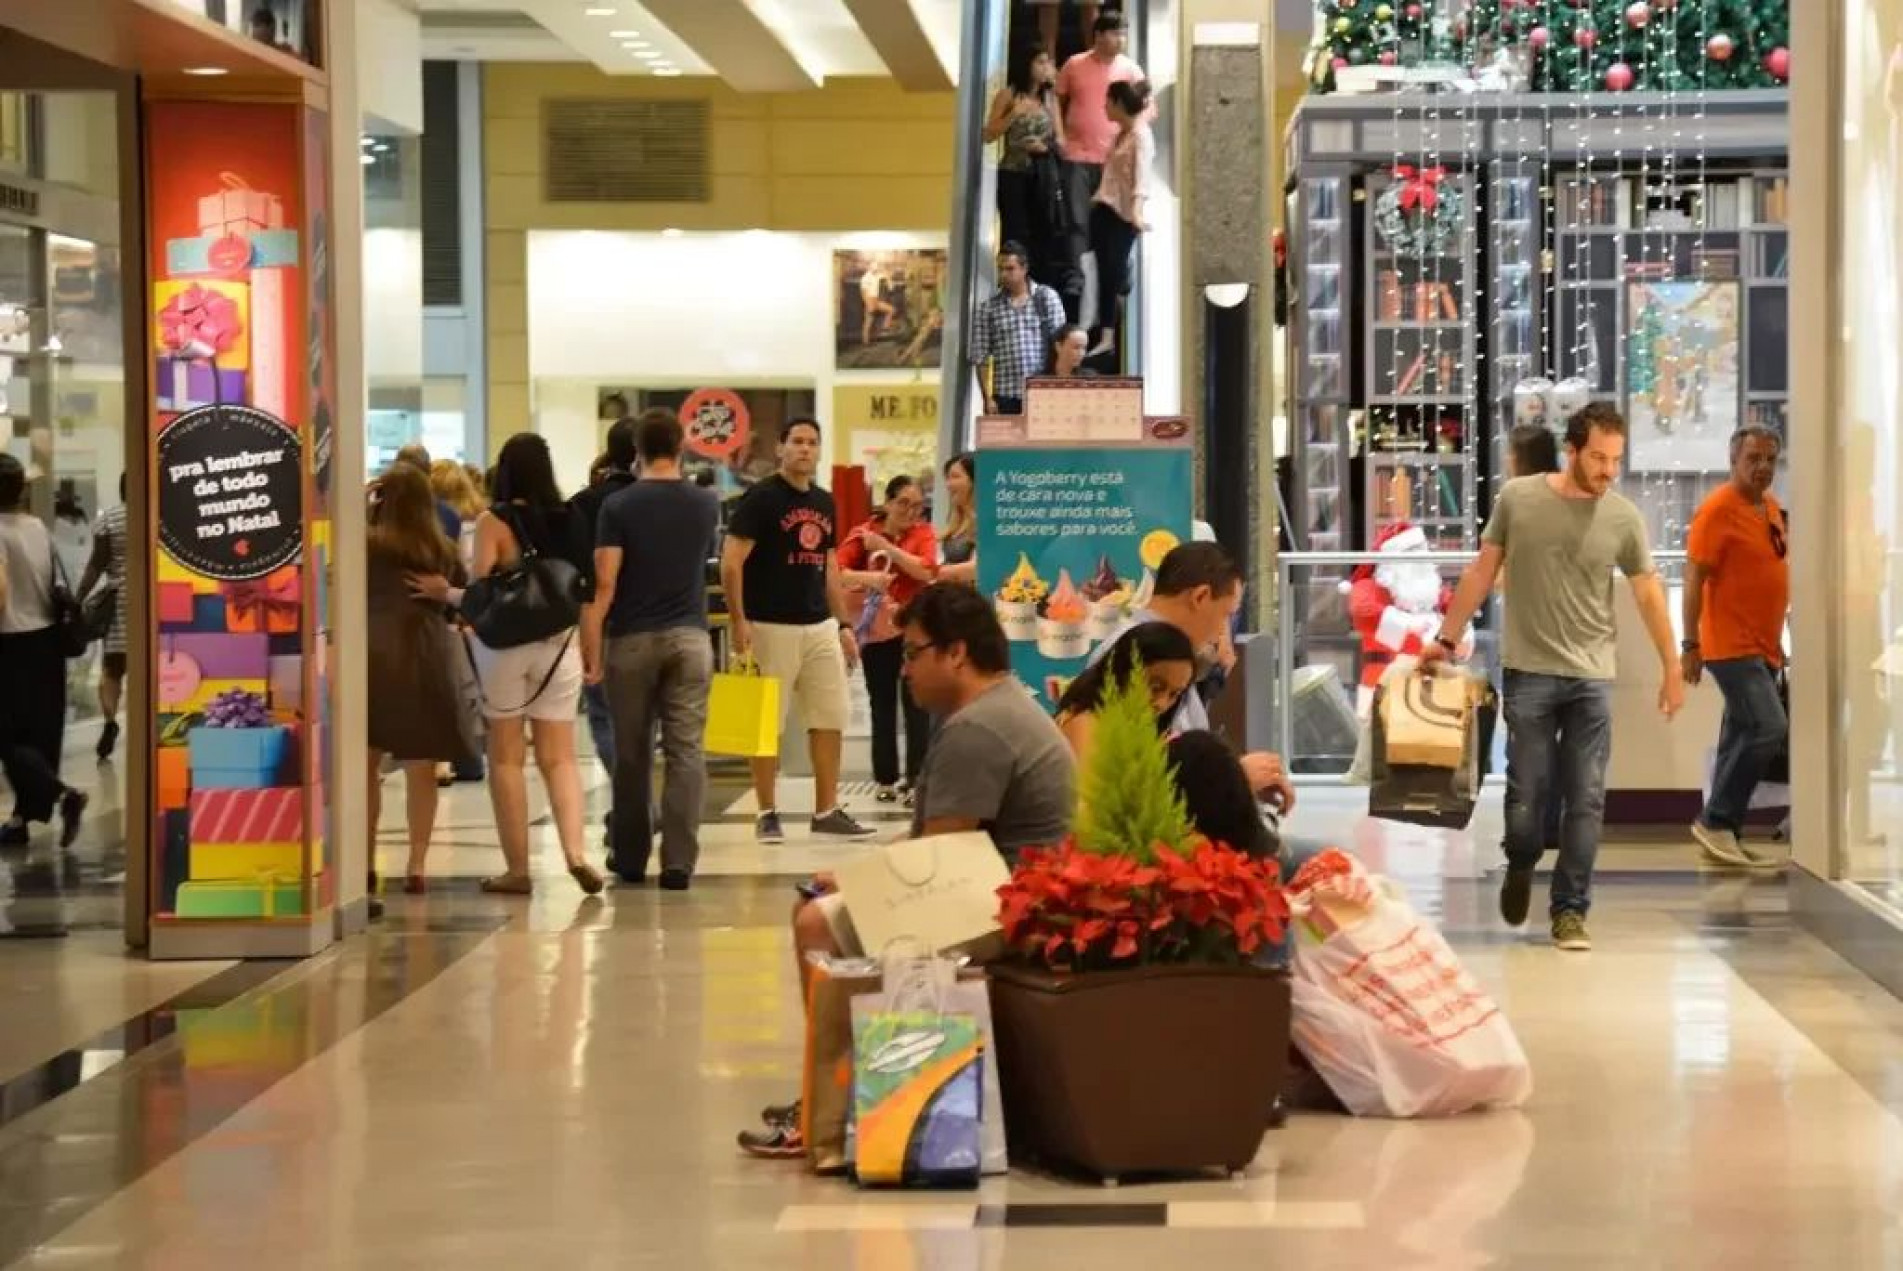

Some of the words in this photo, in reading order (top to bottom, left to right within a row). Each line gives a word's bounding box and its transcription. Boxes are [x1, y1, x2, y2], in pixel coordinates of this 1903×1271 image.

[169, 462, 205, 483] pra
[205, 450, 285, 473] lembrar
[193, 479, 220, 496] de
[221, 472, 269, 492] todo
[995, 471, 1006, 484] A
[198, 492, 272, 516] mundo
[996, 489, 1016, 502] de
[1017, 490, 1052, 502] cara
[1055, 490, 1094, 502] nova
[1097, 490, 1107, 502] e
[996, 506, 1048, 519] trouxe
[1050, 506, 1093, 519] ainda
[1095, 506, 1133, 519] mais
[196, 523, 225, 539] no
[226, 510, 281, 534] Natal
[996, 523, 1058, 536] sabores
[1060, 524, 1097, 538] para
